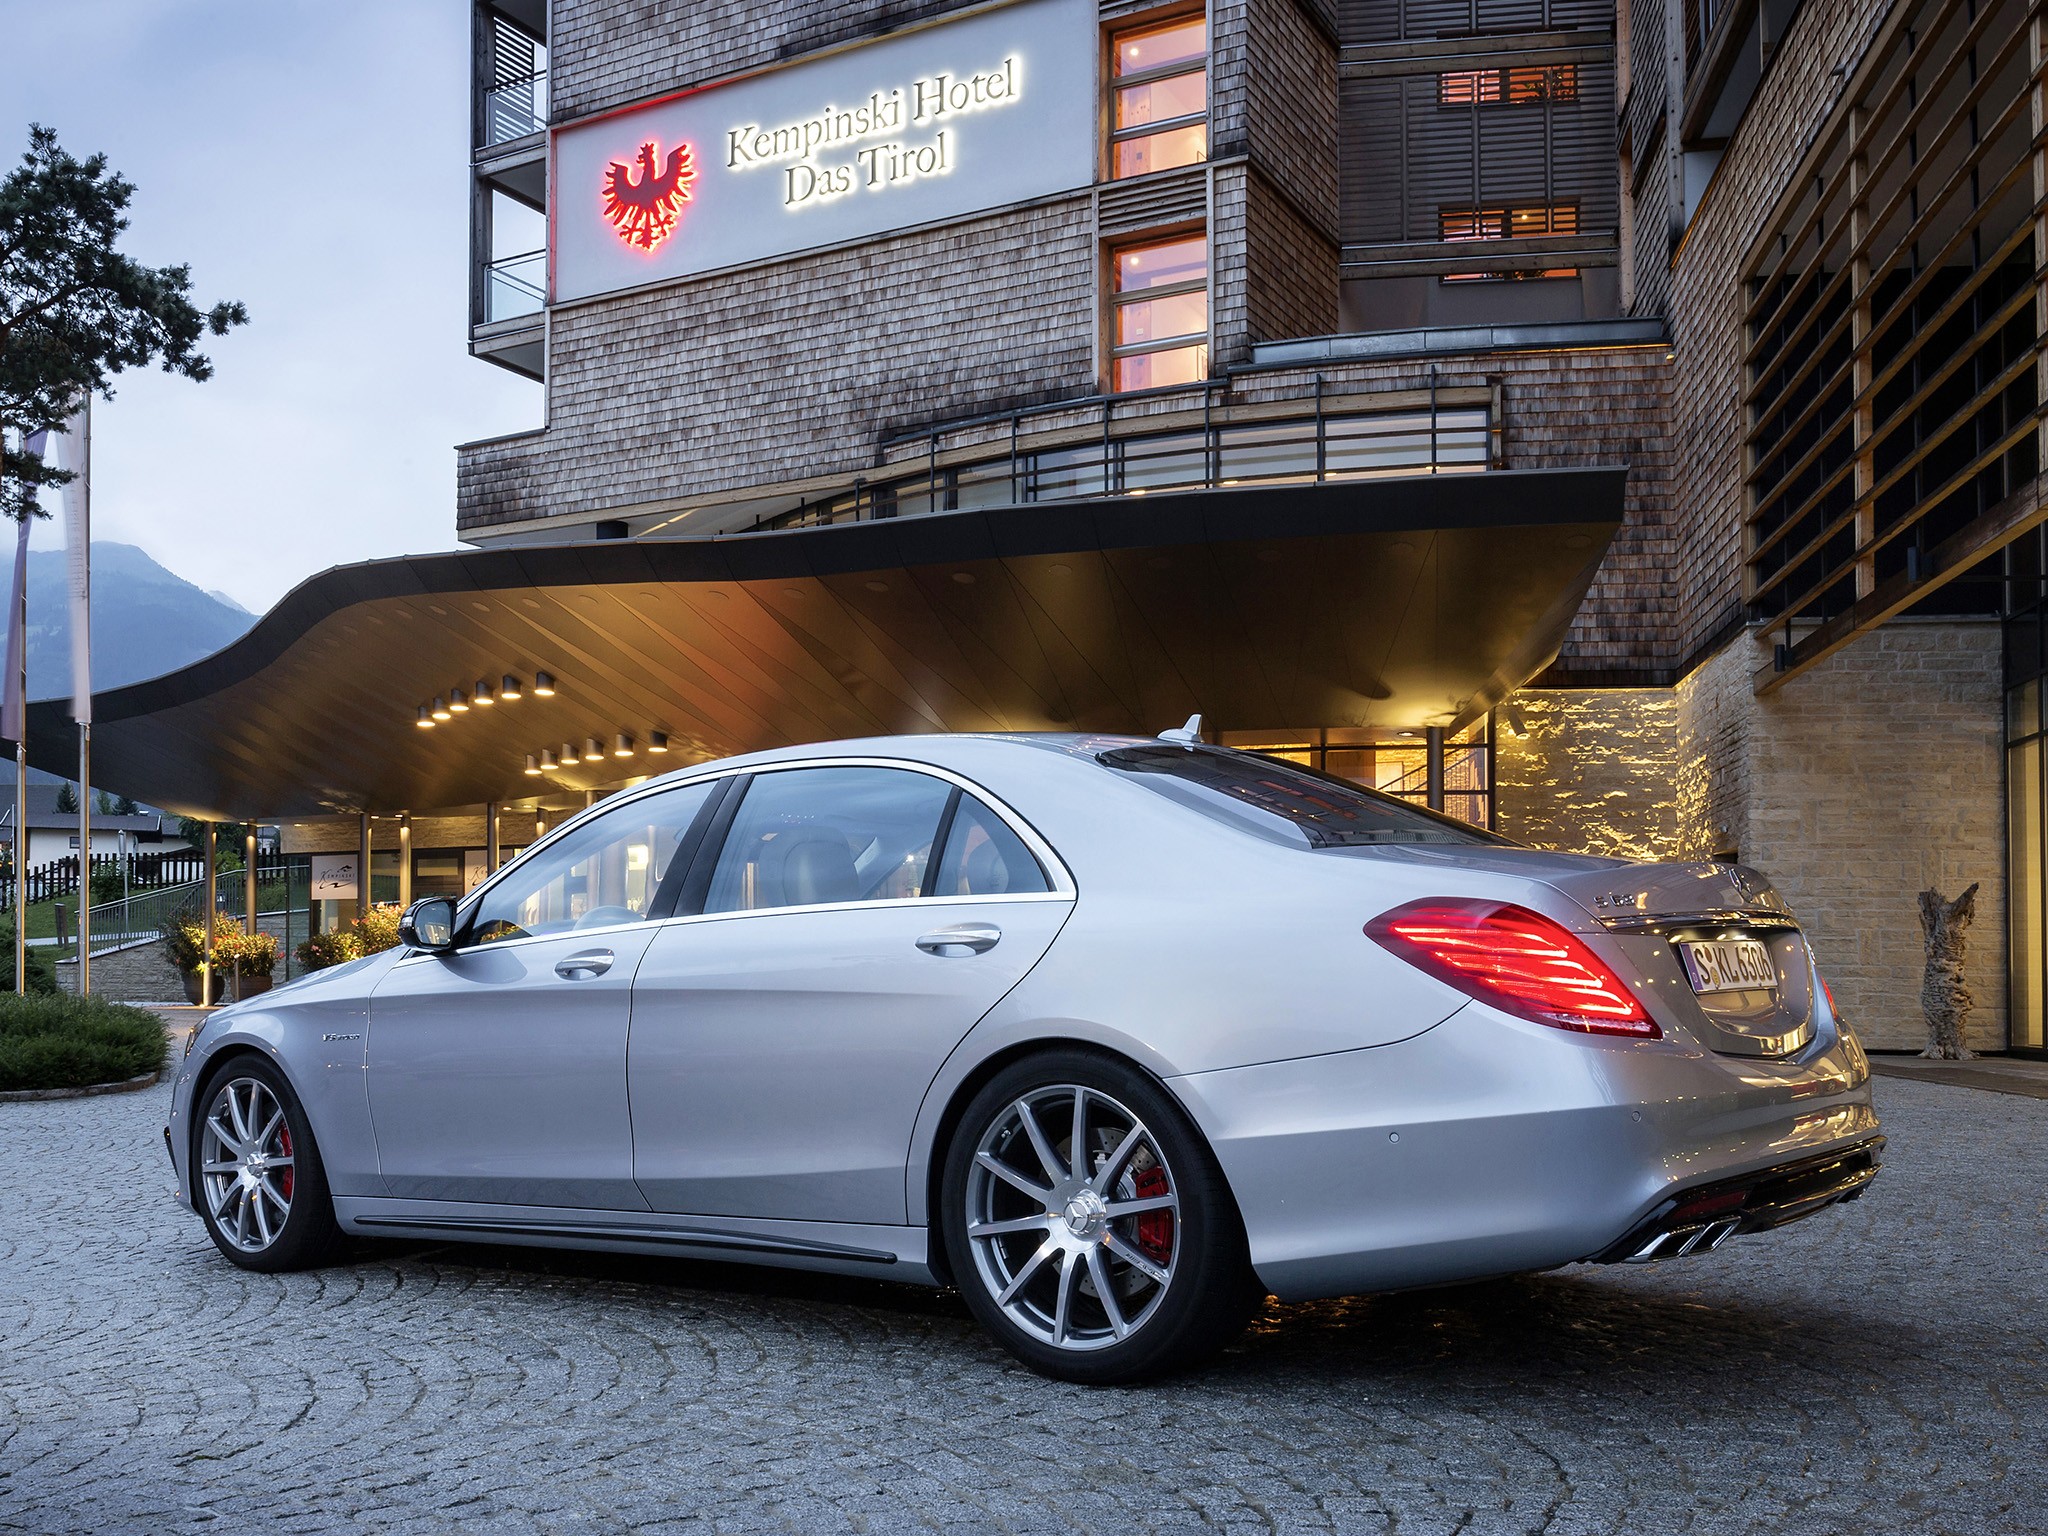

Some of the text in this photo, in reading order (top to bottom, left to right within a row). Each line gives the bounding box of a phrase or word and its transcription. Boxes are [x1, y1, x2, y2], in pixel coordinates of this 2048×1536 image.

[727, 58, 1016, 168] Kempinski Hotel
[785, 131, 946, 205] Das Tirol
